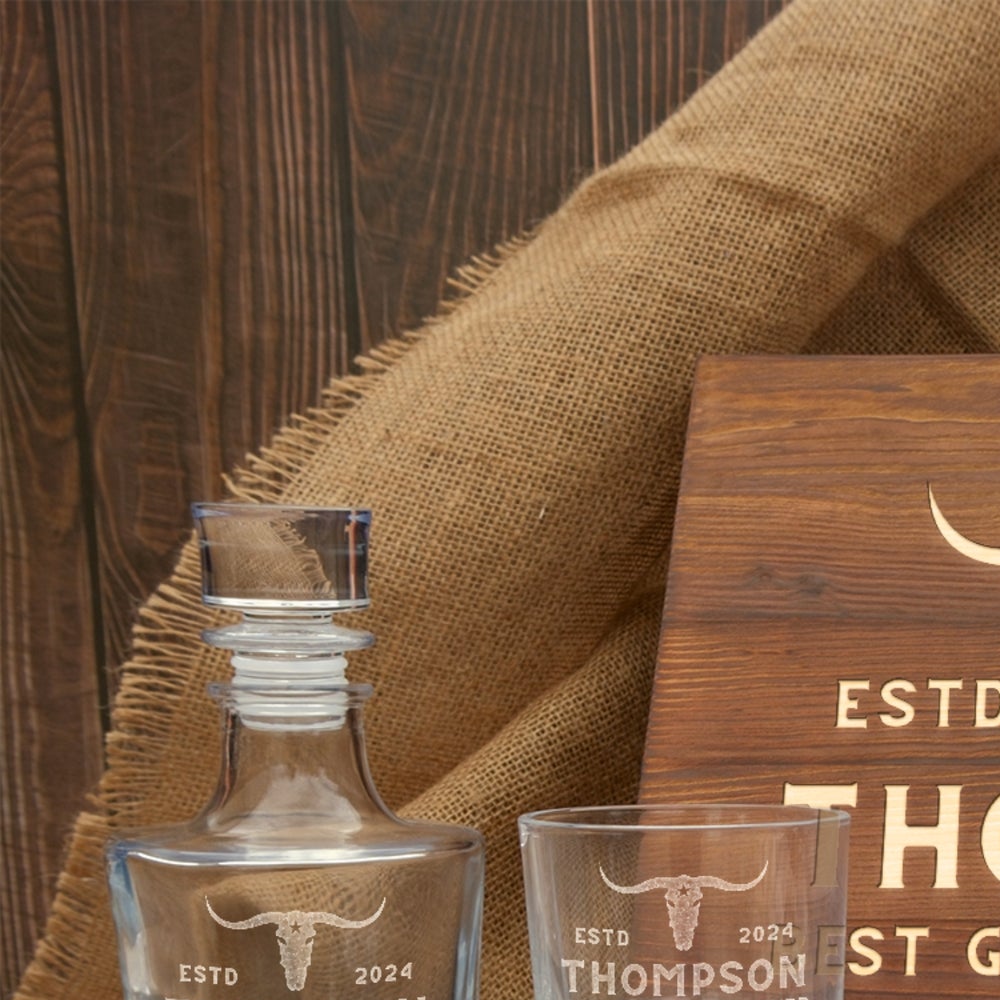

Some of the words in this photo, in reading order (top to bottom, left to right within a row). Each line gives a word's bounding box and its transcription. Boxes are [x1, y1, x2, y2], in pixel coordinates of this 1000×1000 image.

[575, 927, 629, 946] ESTD
[739, 922, 793, 944] 2024
[179, 964, 238, 986] ESTD
[355, 962, 413, 985] 2024
[561, 953, 806, 997] THOMPSON
